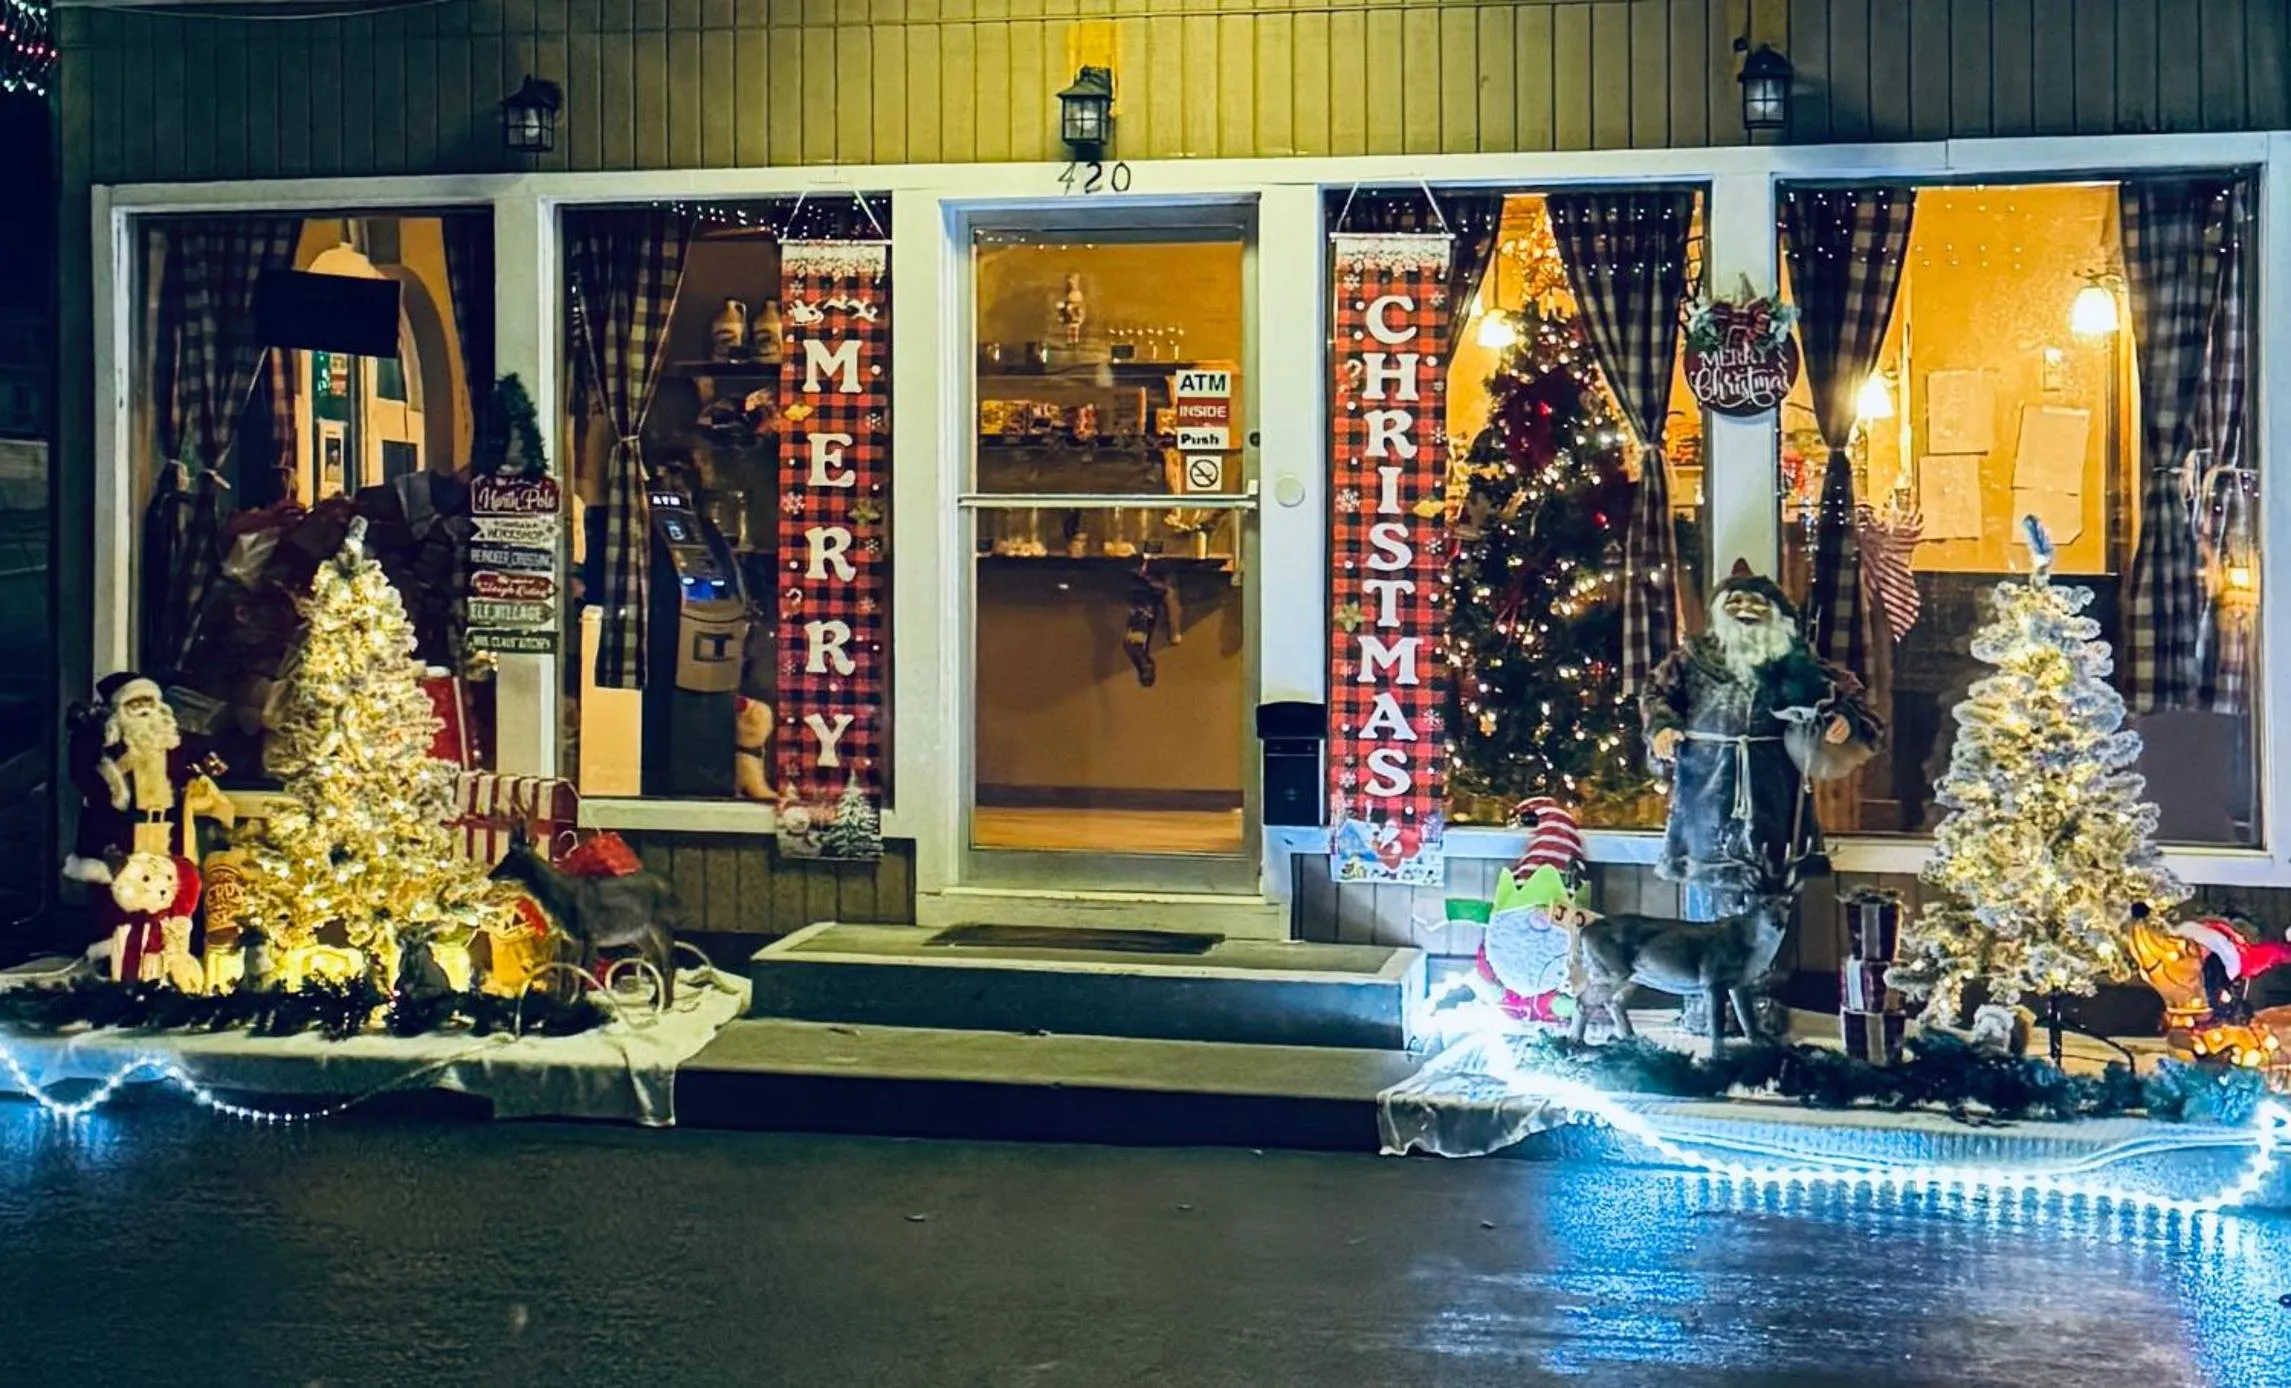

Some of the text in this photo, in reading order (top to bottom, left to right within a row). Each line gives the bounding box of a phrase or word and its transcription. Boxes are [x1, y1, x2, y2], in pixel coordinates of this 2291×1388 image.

[1057, 162, 1131, 194] 420
[1698, 342, 1774, 369] MERRY
[1180, 374, 1226, 391] ATM
[1179, 405, 1227, 418] INSIDE
[1180, 433, 1220, 445] Push
[652, 495, 680, 506] ATM
[802, 339, 864, 768] MERRY
[1356, 295, 1424, 798] CHRISTMAS
